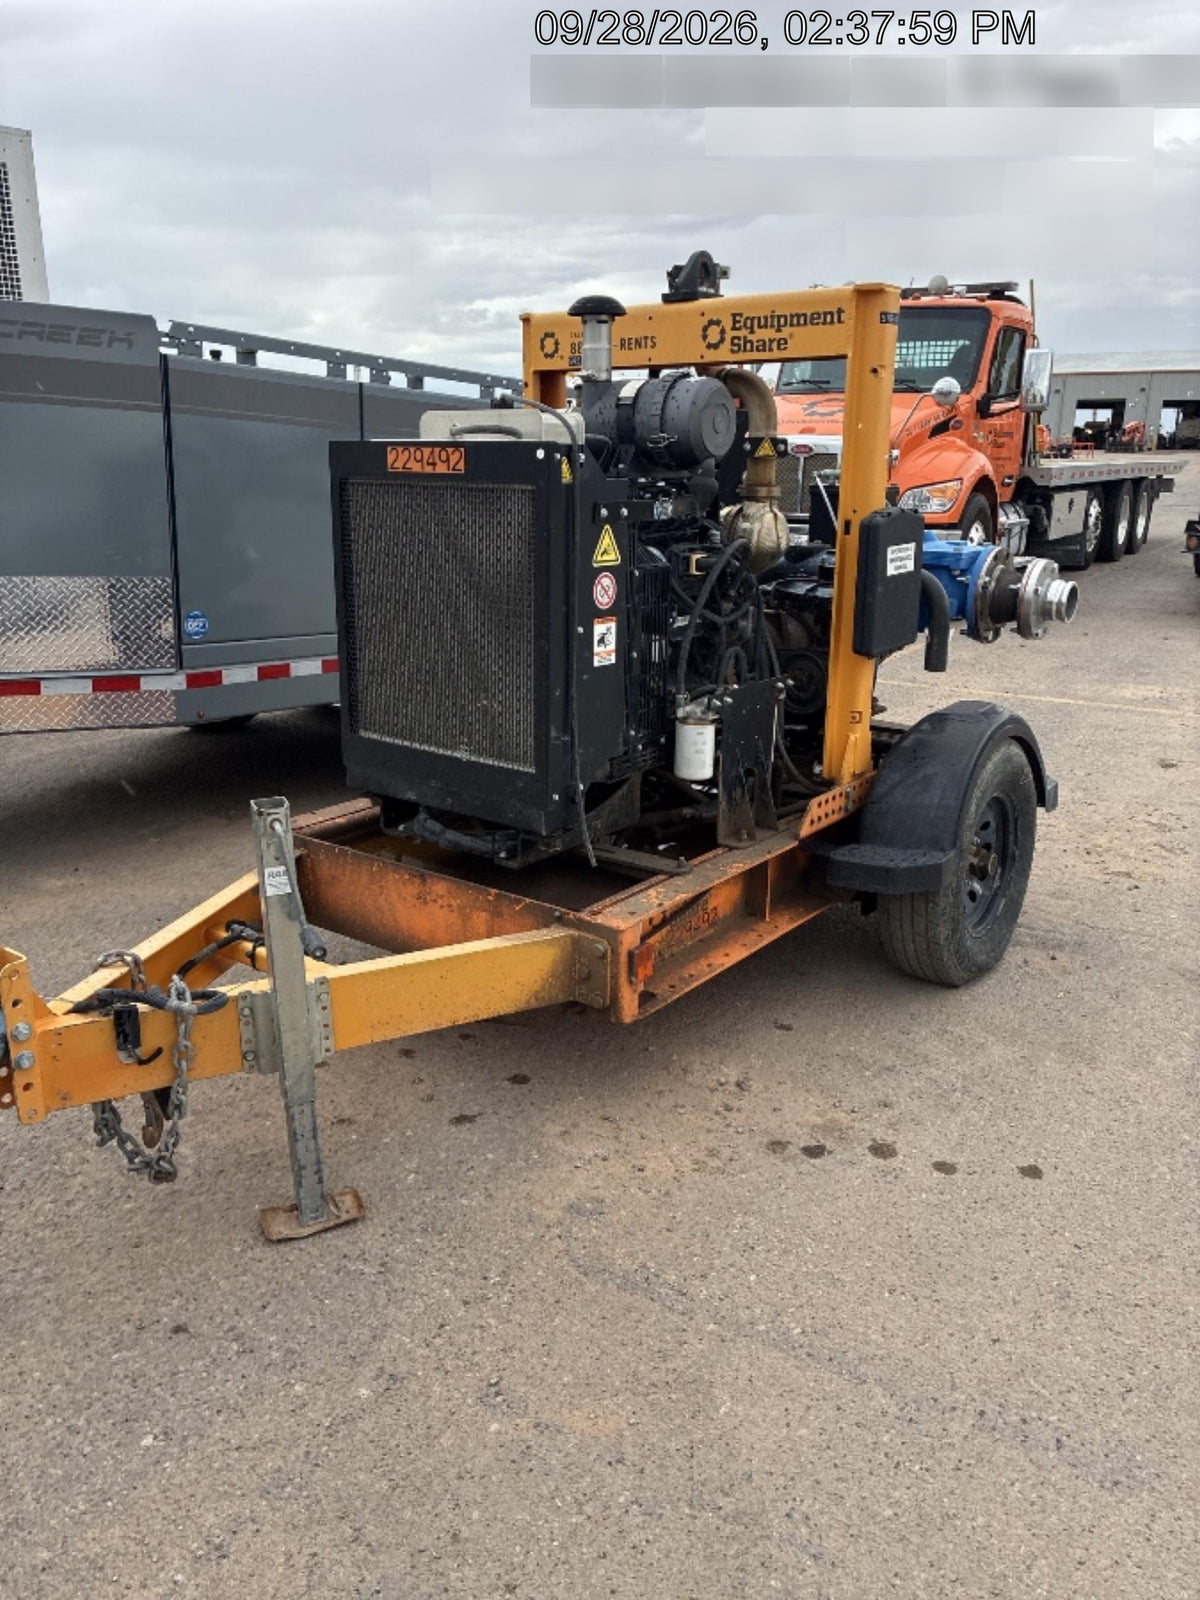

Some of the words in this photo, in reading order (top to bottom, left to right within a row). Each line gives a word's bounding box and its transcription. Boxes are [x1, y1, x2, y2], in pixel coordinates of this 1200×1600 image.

[730, 307, 846, 334] Equipment
[729, 334, 789, 354] Share
[388, 447, 464, 472] 229492
